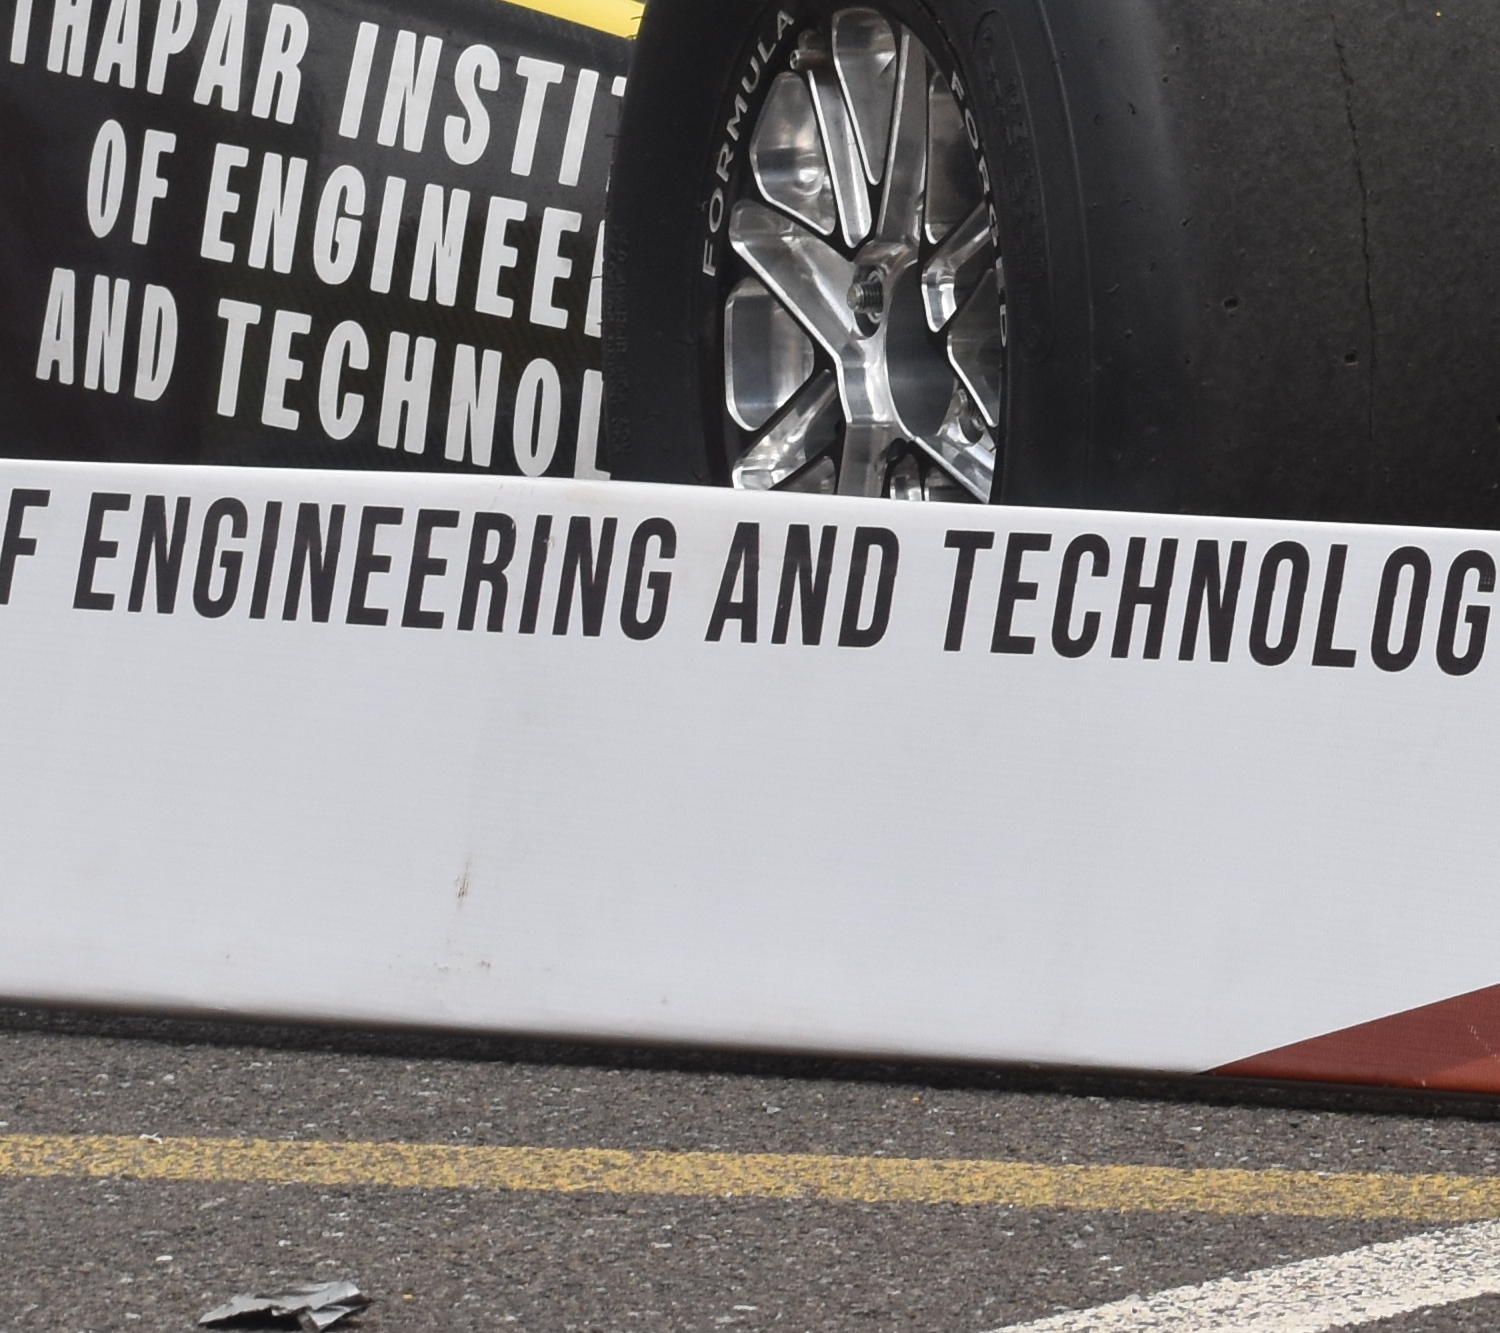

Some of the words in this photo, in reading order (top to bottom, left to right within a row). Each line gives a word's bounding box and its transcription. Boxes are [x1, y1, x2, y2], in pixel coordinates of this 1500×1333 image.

[339, 20, 627, 189] INSTI
[702, 9, 796, 278] FORMULA
[86, 118, 178, 246] OF
[199, 142, 608, 339] ENGINEE
[35, 266, 178, 402] AND
[72, 491, 678, 643] ENGINEERING
[704, 521, 902, 650] AND
